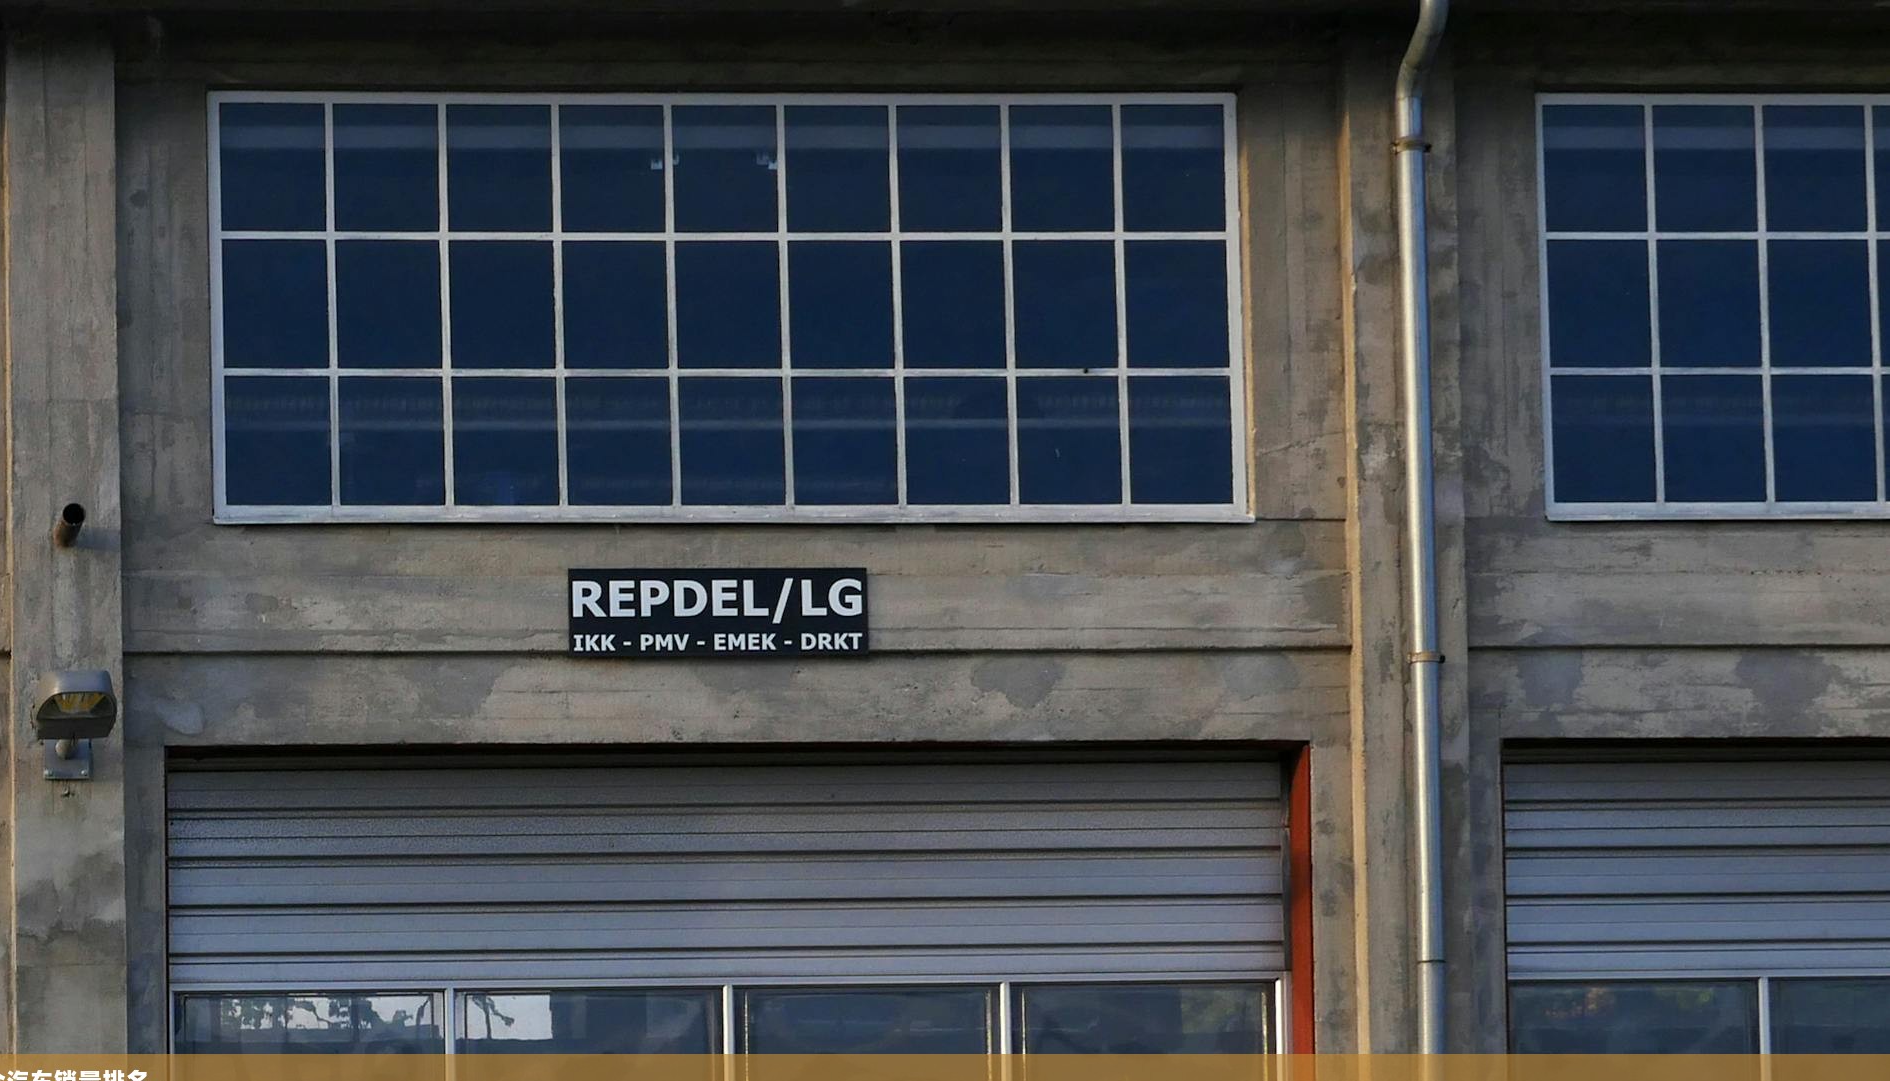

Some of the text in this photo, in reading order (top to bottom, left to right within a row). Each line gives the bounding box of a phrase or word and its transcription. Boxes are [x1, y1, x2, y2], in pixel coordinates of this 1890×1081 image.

[571, 578, 862, 624] REPDEL/LG
[573, 634, 616, 652] IKK
[640, 633, 690, 651] PMV
[713, 633, 777, 651] EMEK
[801, 632, 863, 651] DRKT
